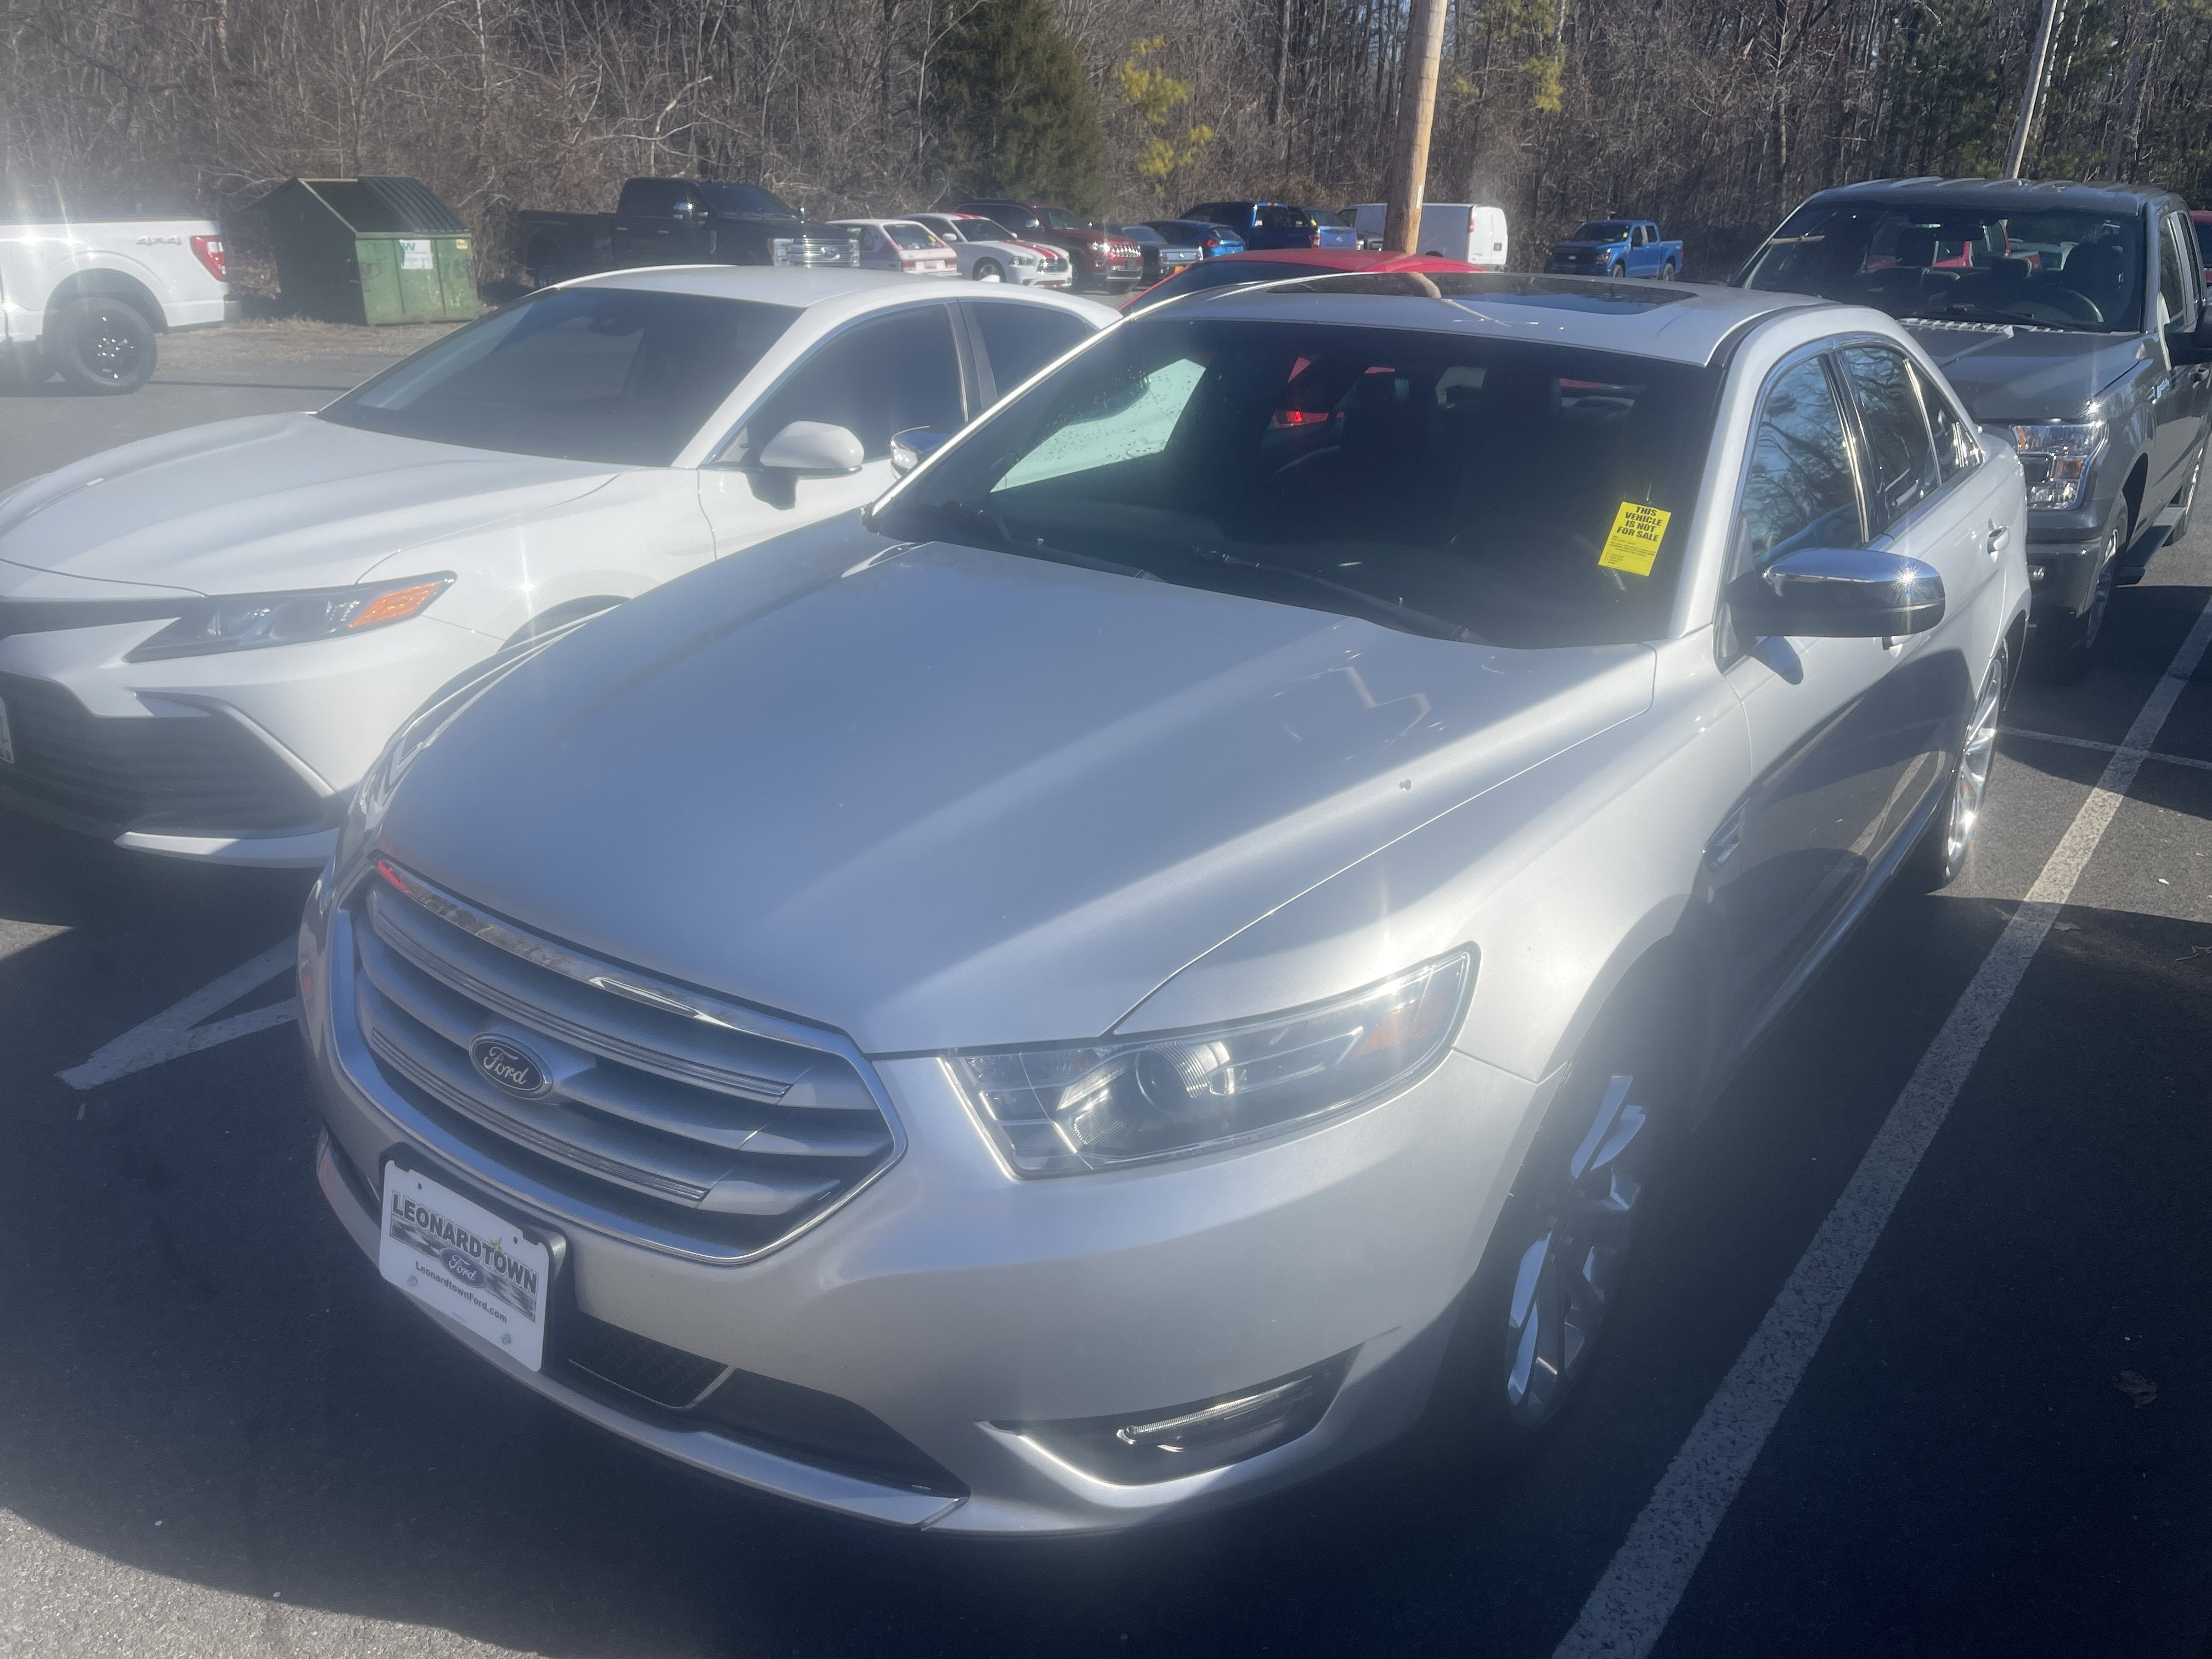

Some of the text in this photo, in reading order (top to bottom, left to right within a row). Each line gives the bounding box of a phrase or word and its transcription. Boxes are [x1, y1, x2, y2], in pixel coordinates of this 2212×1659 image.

[1625, 512, 1662, 526] VEHICLE
[1635, 506, 1657, 516] THIS
[1617, 527, 1635, 537] FOR
[1636, 531, 1660, 541] SALE
[1637, 522, 1656, 533] NOT
[483, 1046, 529, 1085] Ford
[392, 1190, 539, 1295] LEONARDTOWN
[448, 1254, 477, 1282] Ford
[415, 1261, 507, 1323] LeonardtownFord.com
